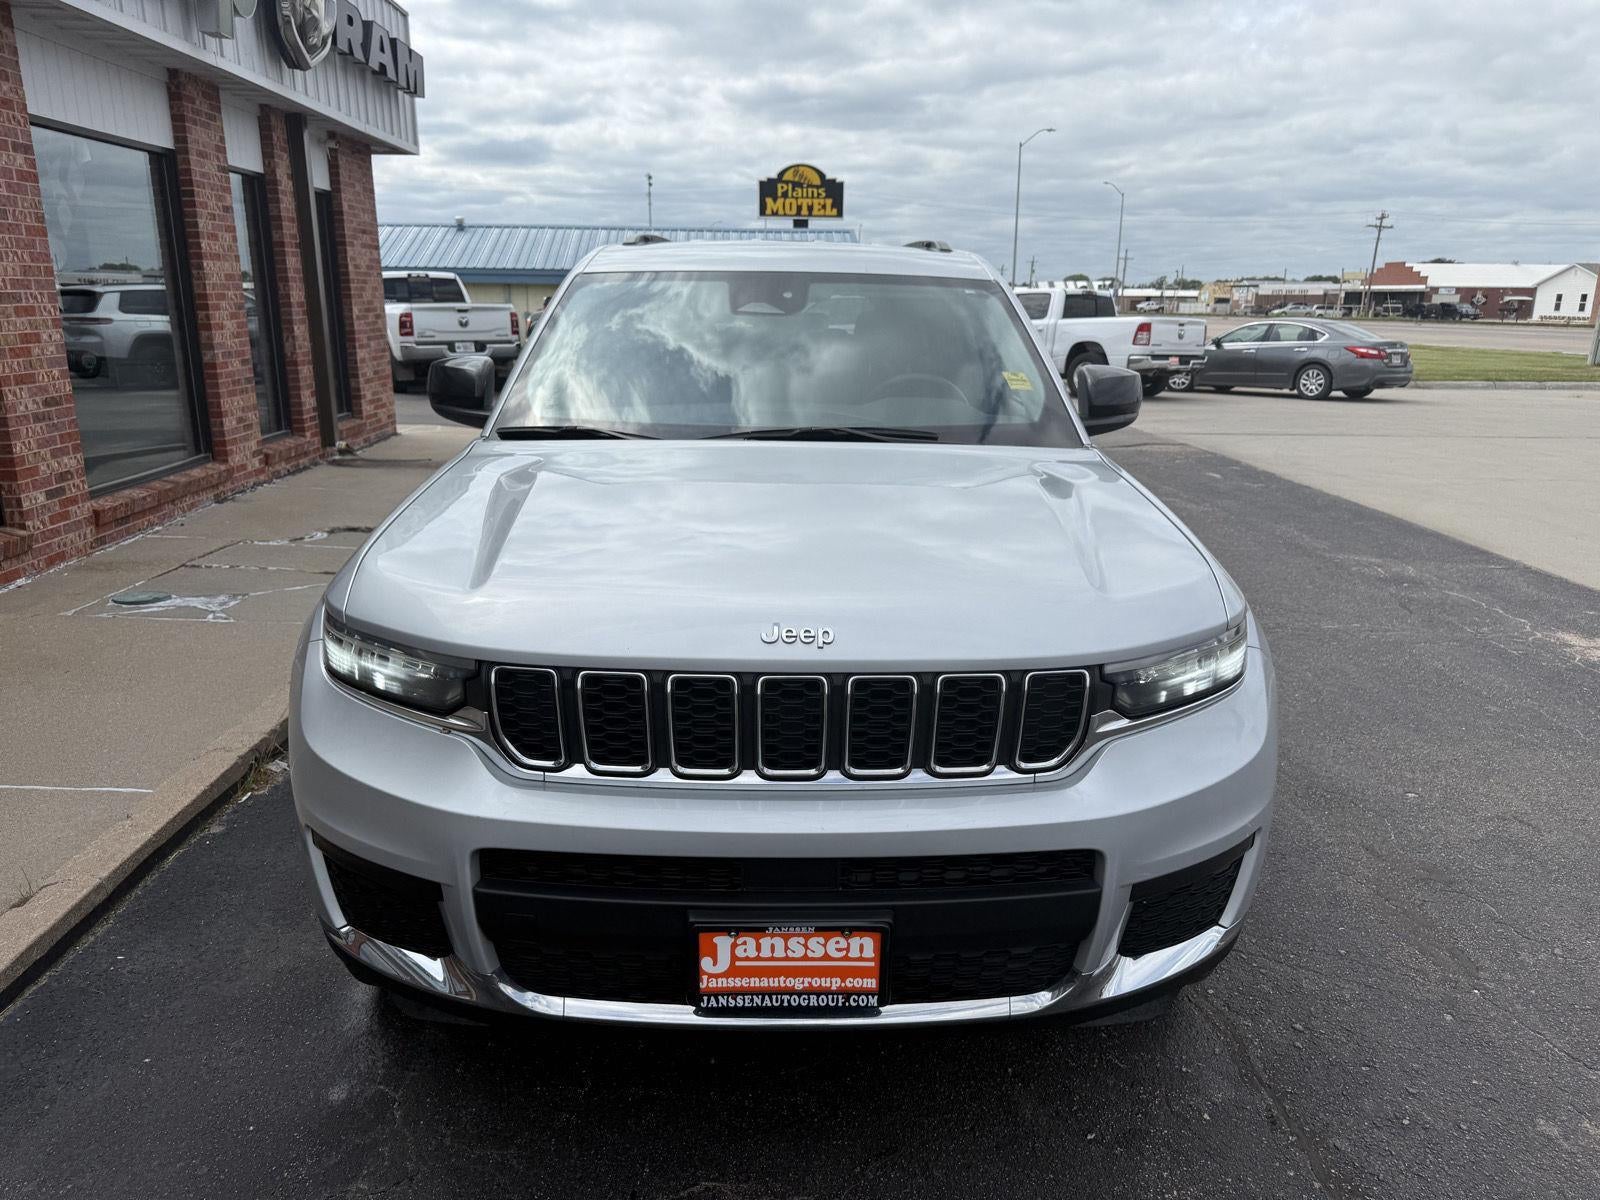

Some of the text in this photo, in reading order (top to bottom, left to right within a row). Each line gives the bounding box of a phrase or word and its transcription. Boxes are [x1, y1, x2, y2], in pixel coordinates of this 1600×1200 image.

[334, 0, 425, 99] RAM
[776, 183, 827, 198] Plains
[765, 197, 838, 216] MOTEL
[760, 622, 835, 650] Jeep
[701, 935, 875, 974] Janssen
